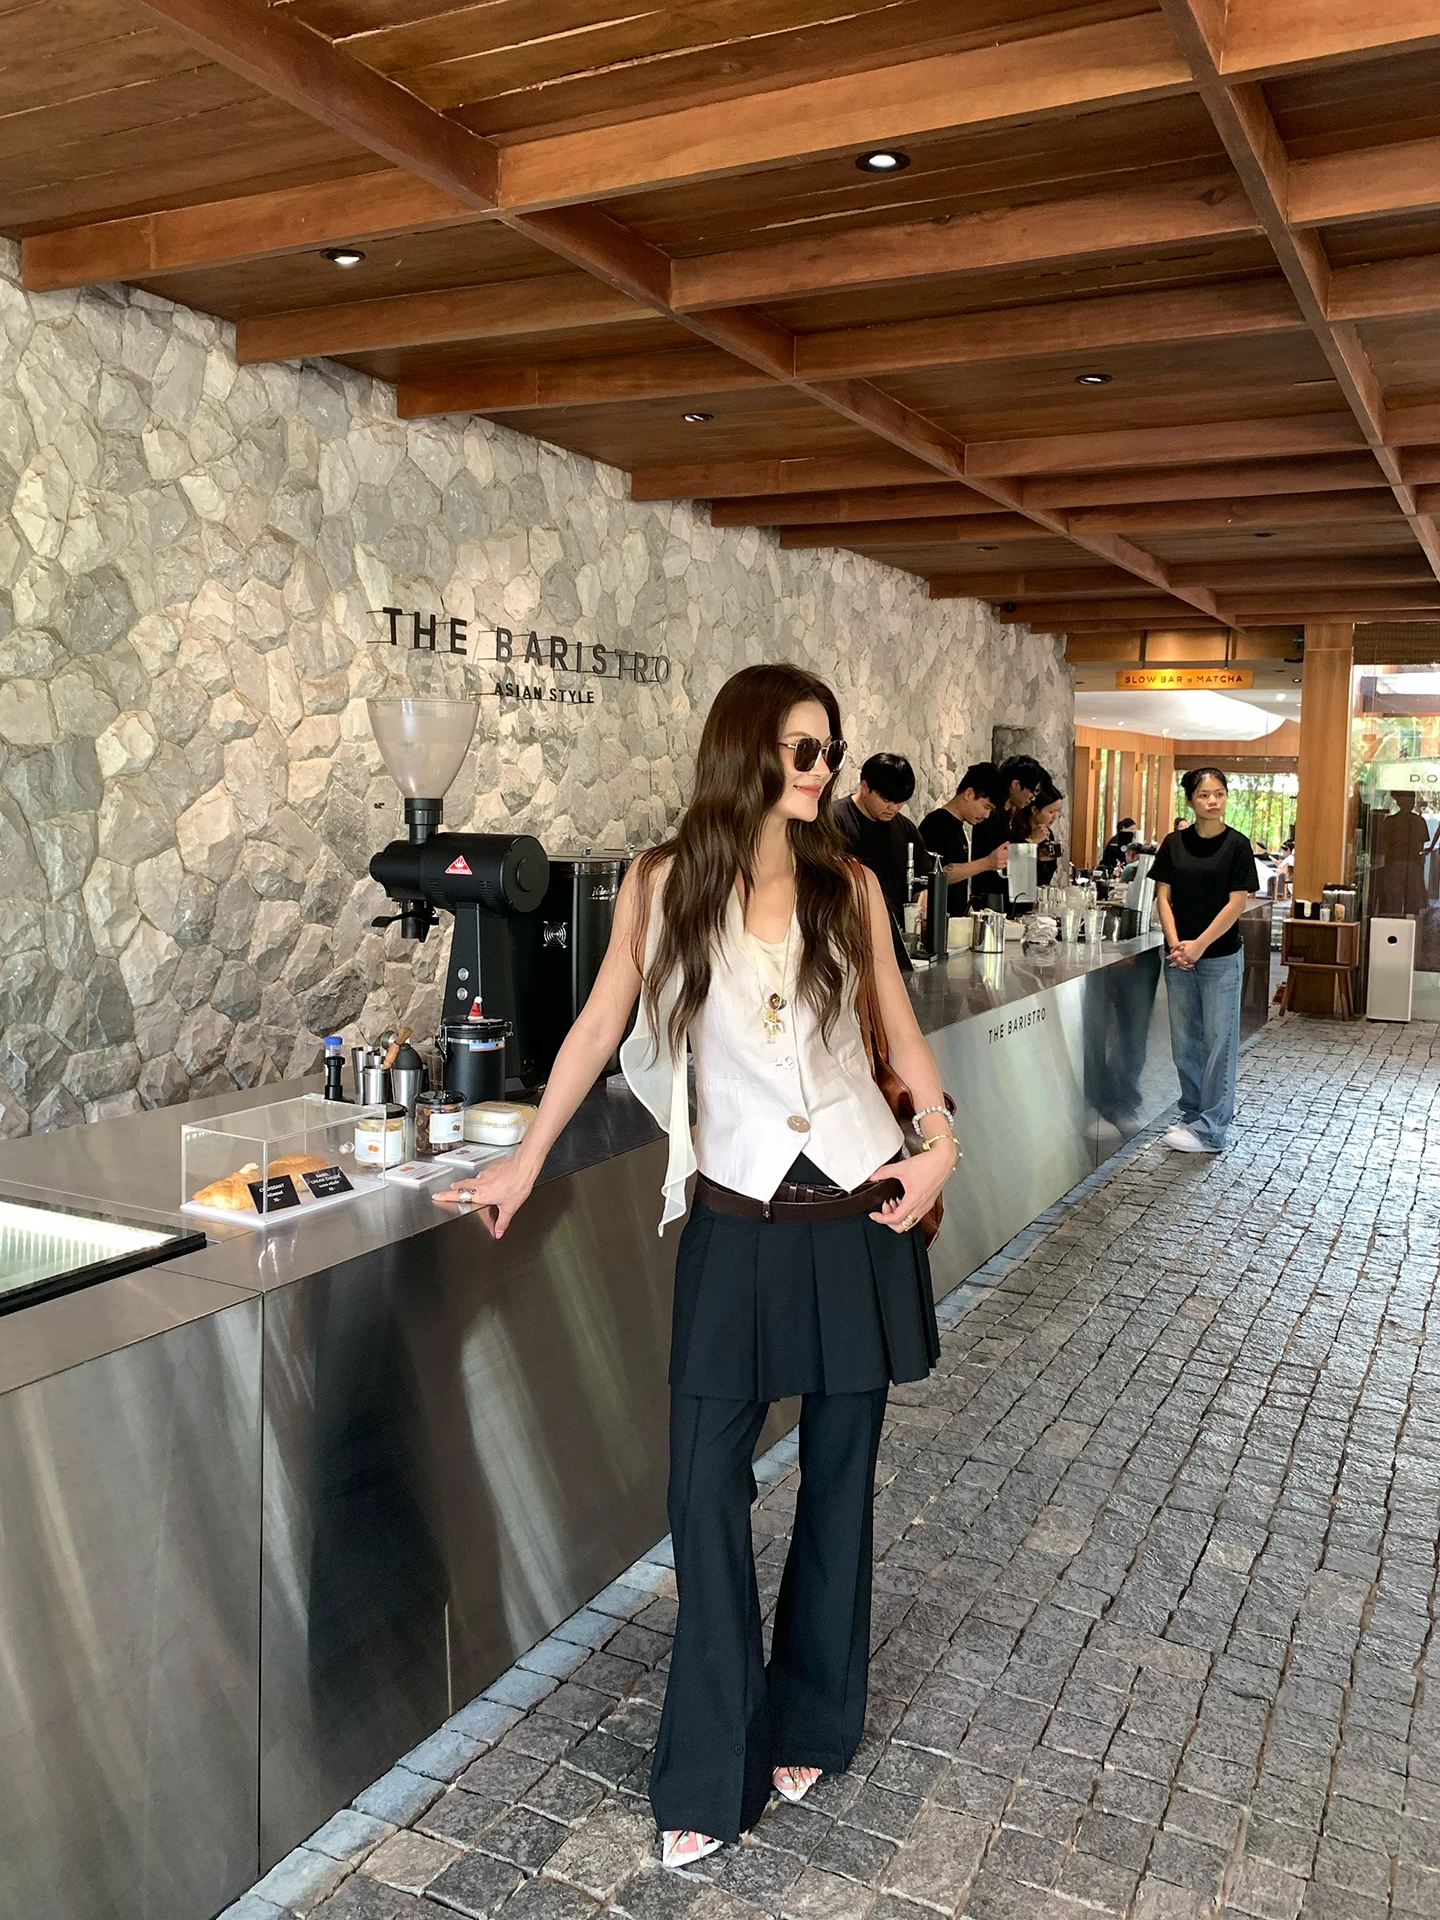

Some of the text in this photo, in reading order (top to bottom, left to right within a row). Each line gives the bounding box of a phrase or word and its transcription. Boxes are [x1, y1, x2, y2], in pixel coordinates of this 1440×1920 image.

[382, 607, 671, 684] THE BARISTRO
[494, 682, 594, 704] ASIAN STYLE
[1125, 676, 1156, 684] SLOW
[1161, 675, 1183, 683] BAR
[1196, 675, 1243, 683] MATCHA
[988, 1008, 1046, 1043] THE BARISTRO
